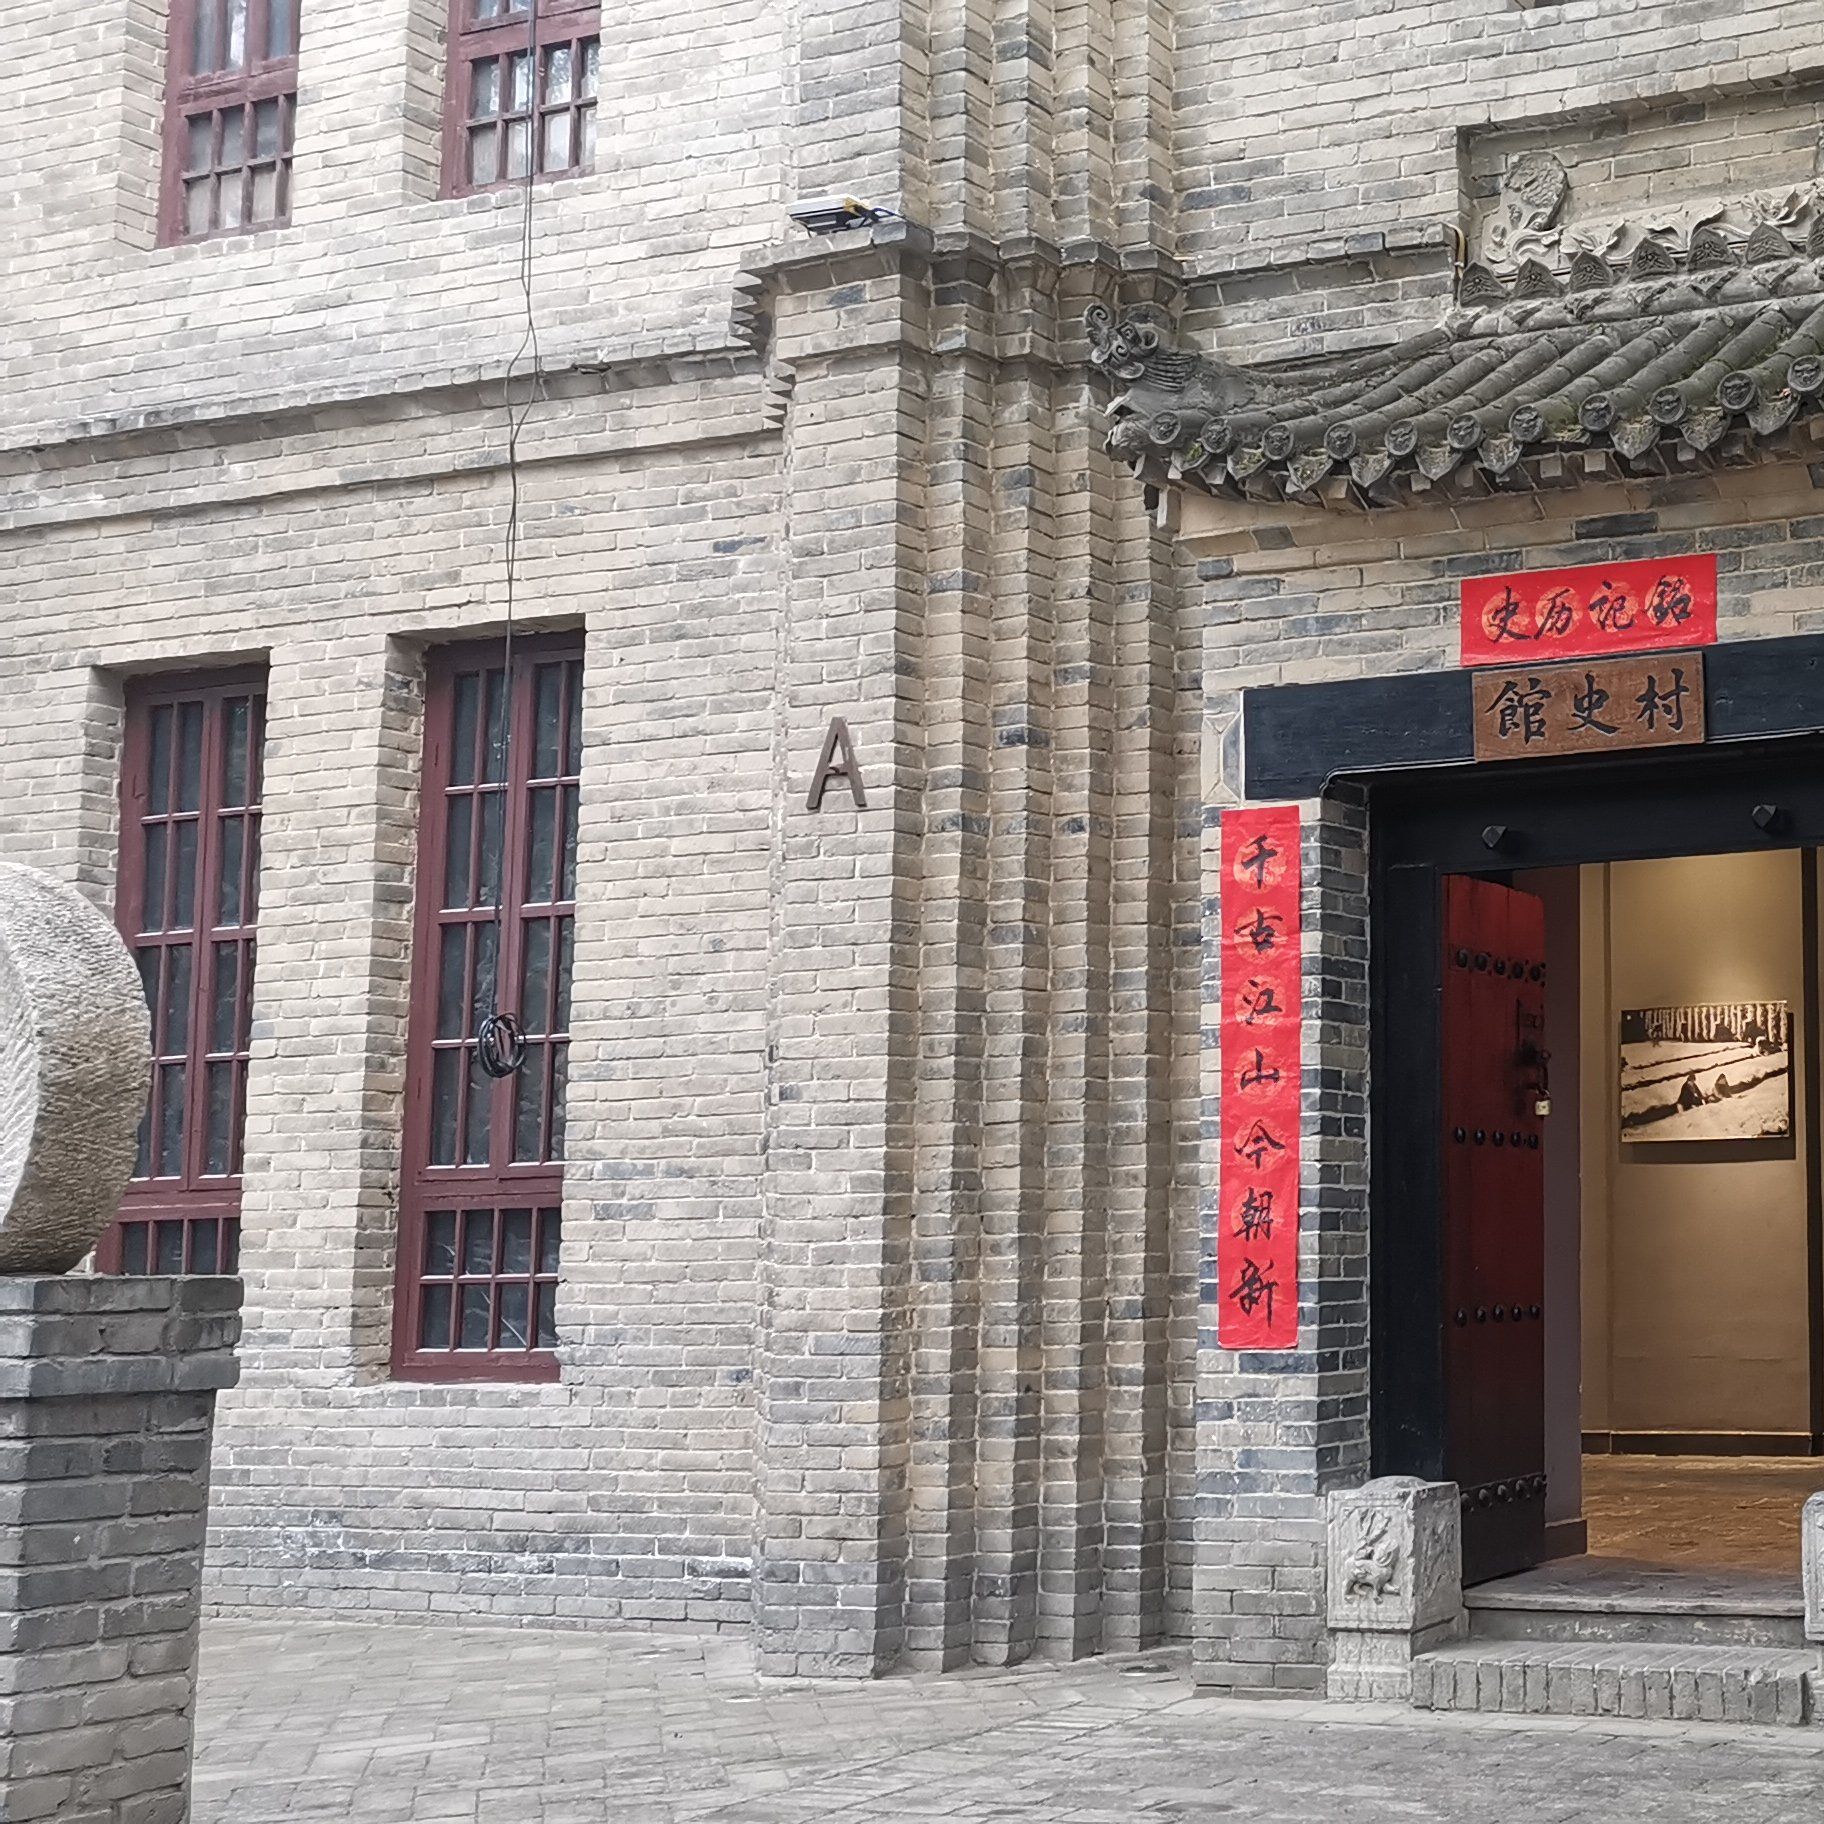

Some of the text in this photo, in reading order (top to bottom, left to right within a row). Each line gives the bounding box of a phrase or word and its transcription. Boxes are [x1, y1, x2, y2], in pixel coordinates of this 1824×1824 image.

[1228, 833, 1287, 1329] 千古江山今朝新
